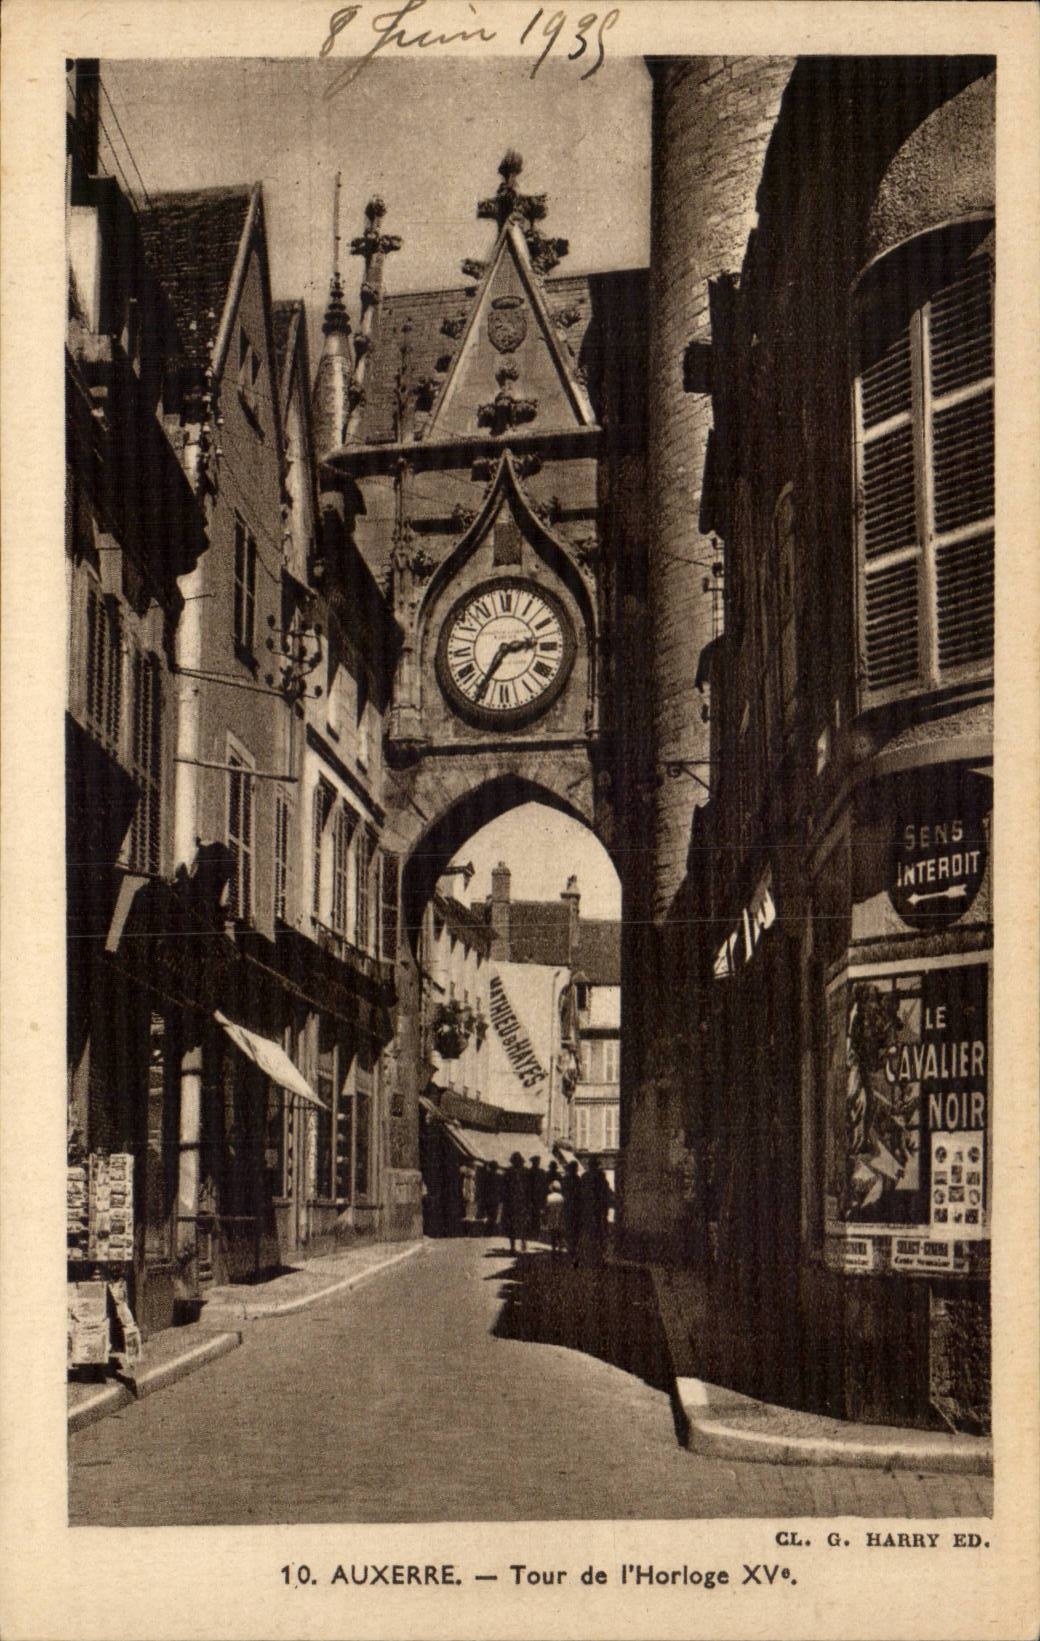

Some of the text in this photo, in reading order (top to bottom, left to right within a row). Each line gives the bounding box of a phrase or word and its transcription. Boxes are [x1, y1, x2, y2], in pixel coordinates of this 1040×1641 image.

[319, 4, 362, 58] 8
[322, 0, 497, 101] Juin
[904, 819, 964, 851] SENS
[897, 850, 980, 887] INTERDIT
[925, 1006, 947, 1029] LE
[885, 1040, 985, 1082] CAVALIER
[928, 1091, 985, 1129] NOIR
